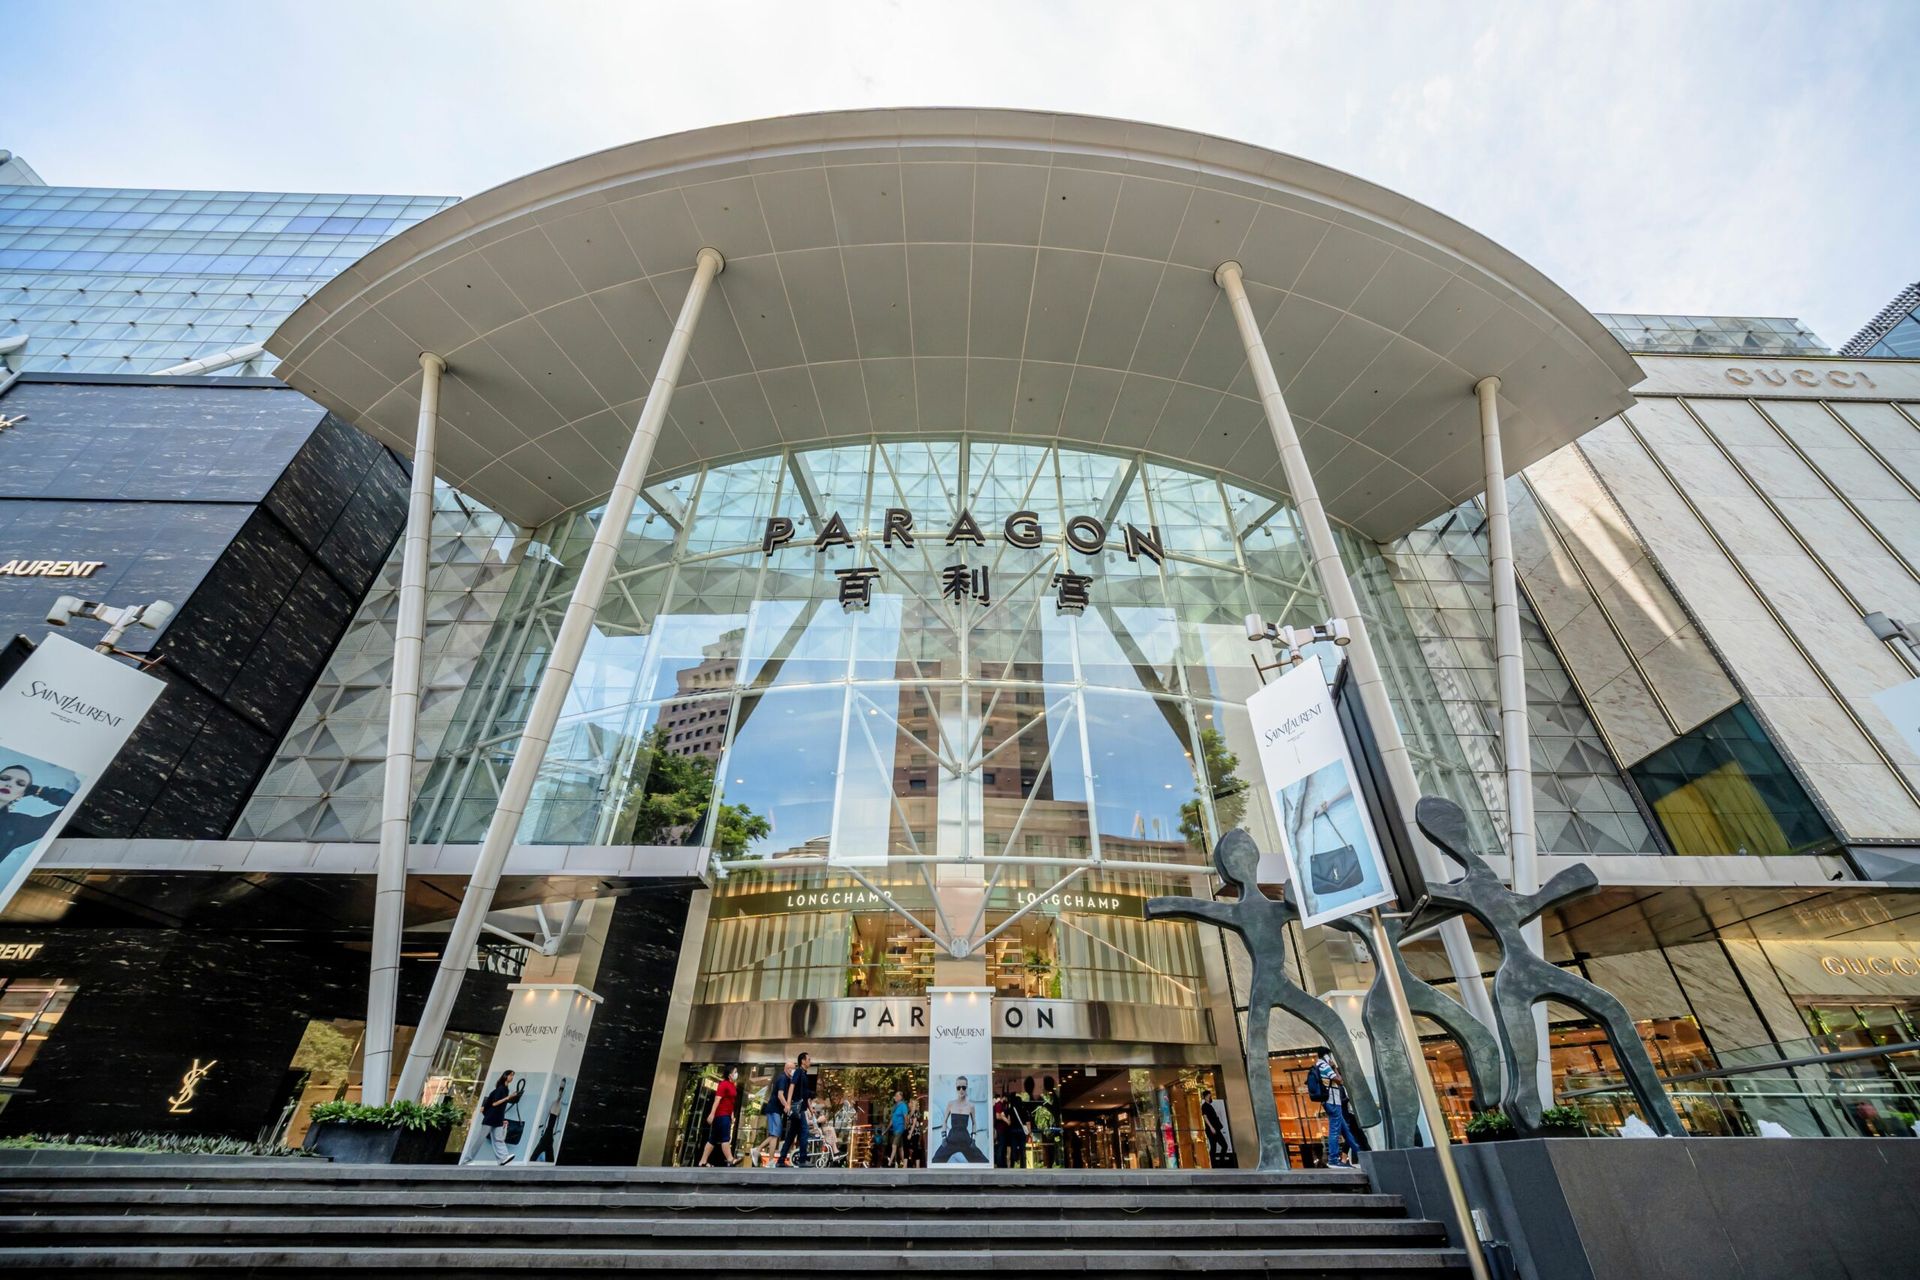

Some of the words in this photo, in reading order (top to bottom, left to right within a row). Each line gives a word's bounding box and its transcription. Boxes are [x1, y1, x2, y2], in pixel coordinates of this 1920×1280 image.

[1724, 368, 1878, 389] GUCCI
[762, 507, 1165, 565] PARAGON
[1018, 892, 1120, 910] LOGCHAMP
[853, 1006, 1054, 1029] PARON
